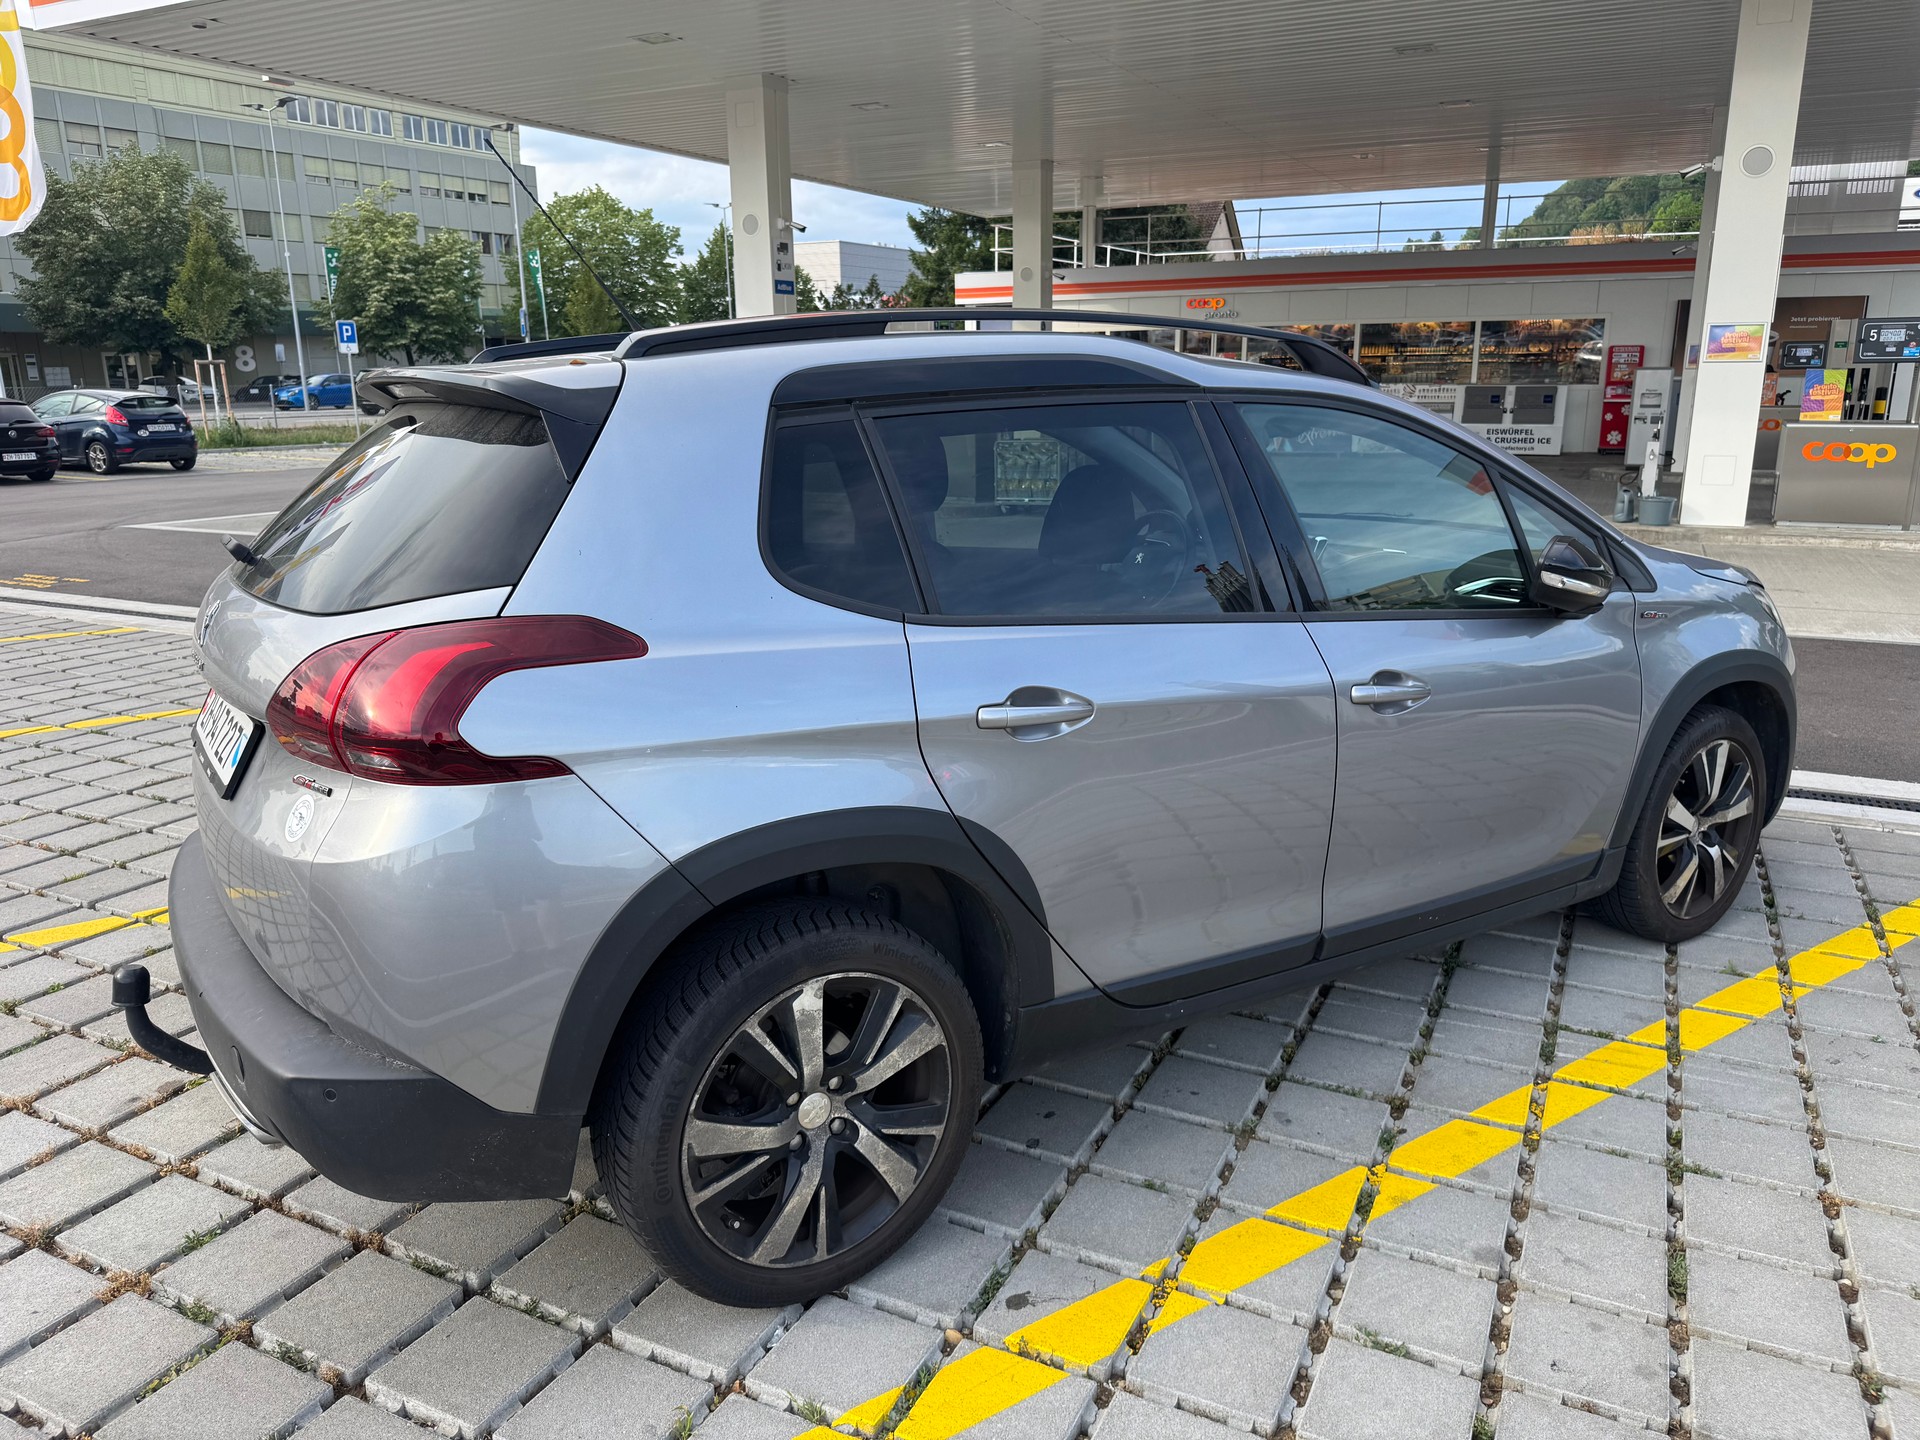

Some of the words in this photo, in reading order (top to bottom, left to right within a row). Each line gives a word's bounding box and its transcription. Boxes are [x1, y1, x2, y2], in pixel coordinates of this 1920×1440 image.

[1186, 297, 1225, 311] coop
[1205, 309, 1239, 320] pronto
[342, 325, 352, 341] P
[1724, 331, 1748, 339] Pronto
[1869, 329, 1878, 341] 5
[1721, 335, 1750, 344] festival
[1790, 348, 1796, 356] 7
[235, 345, 256, 373] 8
[1809, 387, 1839, 396] festival
[1486, 427, 1534, 436] EISWÜRFEL
[1494, 437, 1535, 445] CRUSHED
[1537, 437, 1552, 445] ICE
[1802, 441, 1897, 468] coop
[873, 942, 947, 990] WinterContact
[652, 1094, 682, 1205] Continental
